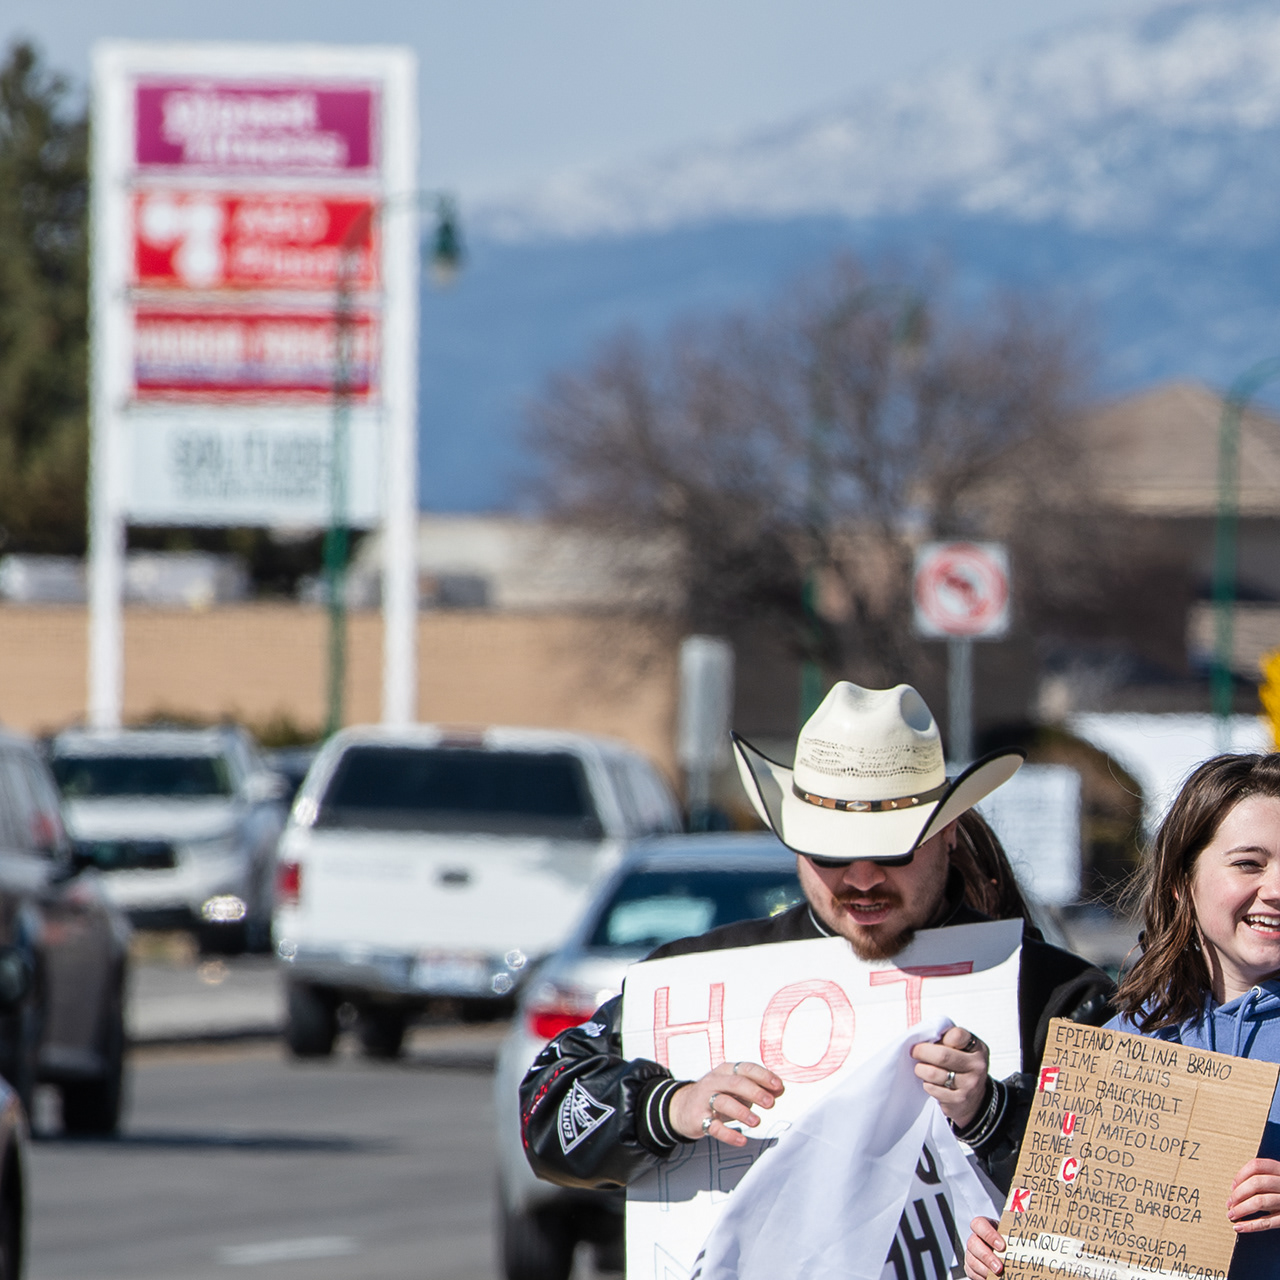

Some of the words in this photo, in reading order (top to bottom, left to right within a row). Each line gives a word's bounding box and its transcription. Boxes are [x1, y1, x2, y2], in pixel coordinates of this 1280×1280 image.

[652, 960, 974, 1083] HOT
[1052, 1047, 1100, 1074] JAIME
[1111, 1060, 1171, 1088] ALANIS
[1115, 1038, 1178, 1067] MOLINA
[1187, 1053, 1232, 1080] BRAVO
[1038, 1066, 1090, 1093] FELIX
[1095, 1080, 1182, 1115] BAUCKHOLT
[1042, 1091, 1060, 1109] DR
[1063, 1096, 1103, 1118] LINDA
[1112, 1104, 1160, 1130] DAVIS
[1034, 1110, 1088, 1137] MANUEL
[1095, 1122, 1147, 1149] MATEO
[1150, 1134, 1201, 1161] LOPEZ
[1079, 1142, 1135, 1168] GOOD
[1019, 1174, 1060, 1196] ISAIS
[1065, 1183, 1129, 1210] SANCHEZ
[1135, 1201, 1202, 1224] BARBOZA
[1024, 1152, 1061, 1178] JOSE
[1062, 1157, 1200, 1207] CASTRO-RIVERA
[1010, 1188, 1061, 1216] KEITH
[1067, 1201, 1135, 1231] PORTER
[1007, 1228, 1071, 1255] ENRIQUE
[1075, 1242, 1120, 1265] JUAN
[1126, 1251, 1166, 1276] TIZOL
[1013, 1212, 1048, 1229] RYAN
[1051, 1217, 1098, 1240] LOUIS
[1102, 1228, 1187, 1261] MOSQUEDA
[1002, 1251, 1044, 1275] ELENA
